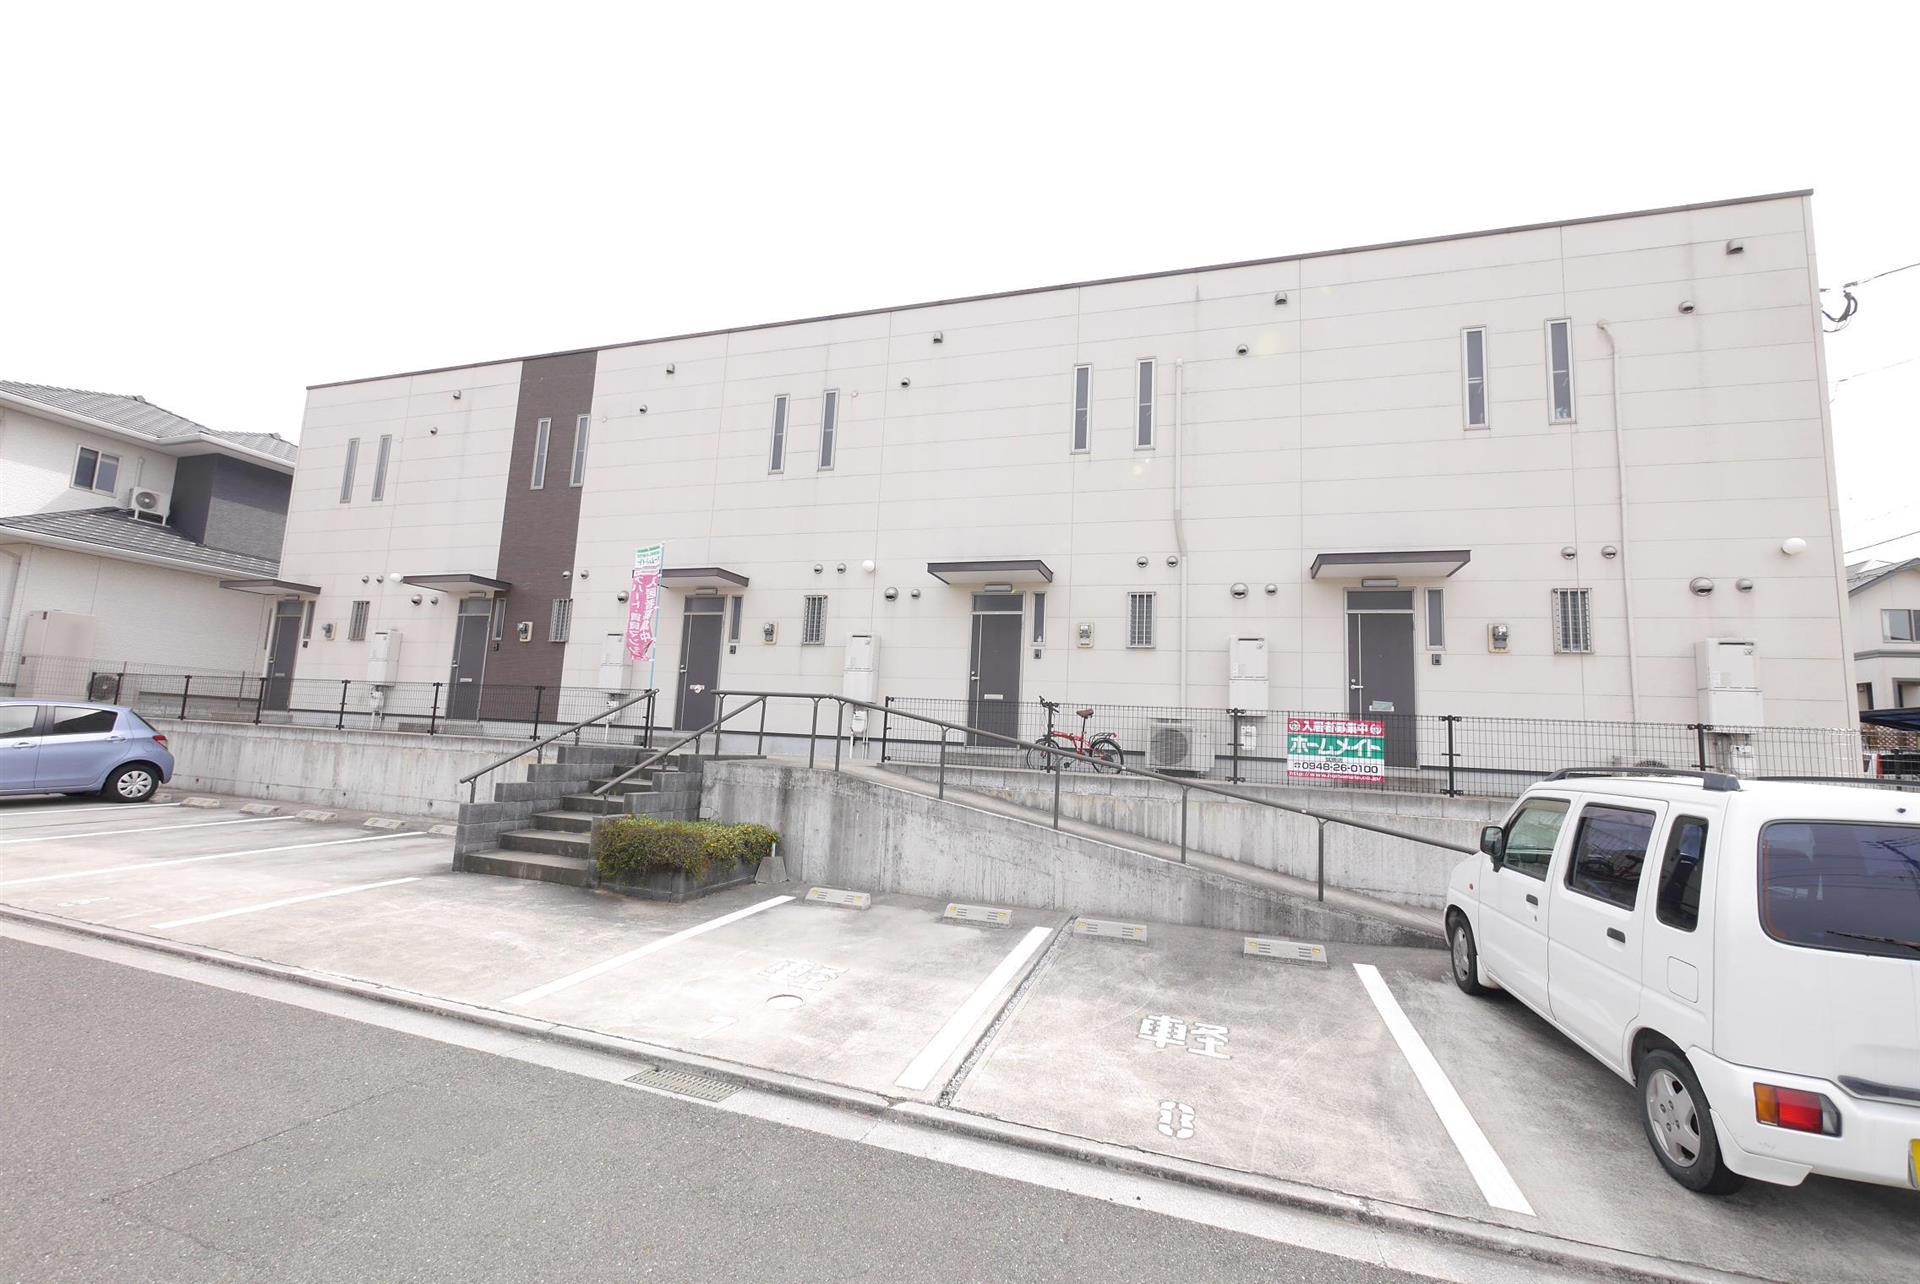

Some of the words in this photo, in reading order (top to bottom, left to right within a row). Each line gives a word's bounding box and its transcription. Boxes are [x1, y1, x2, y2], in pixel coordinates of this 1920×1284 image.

[1290, 735, 1381, 757] ホームメイト
[1138, 1015, 1232, 1059] 軽
